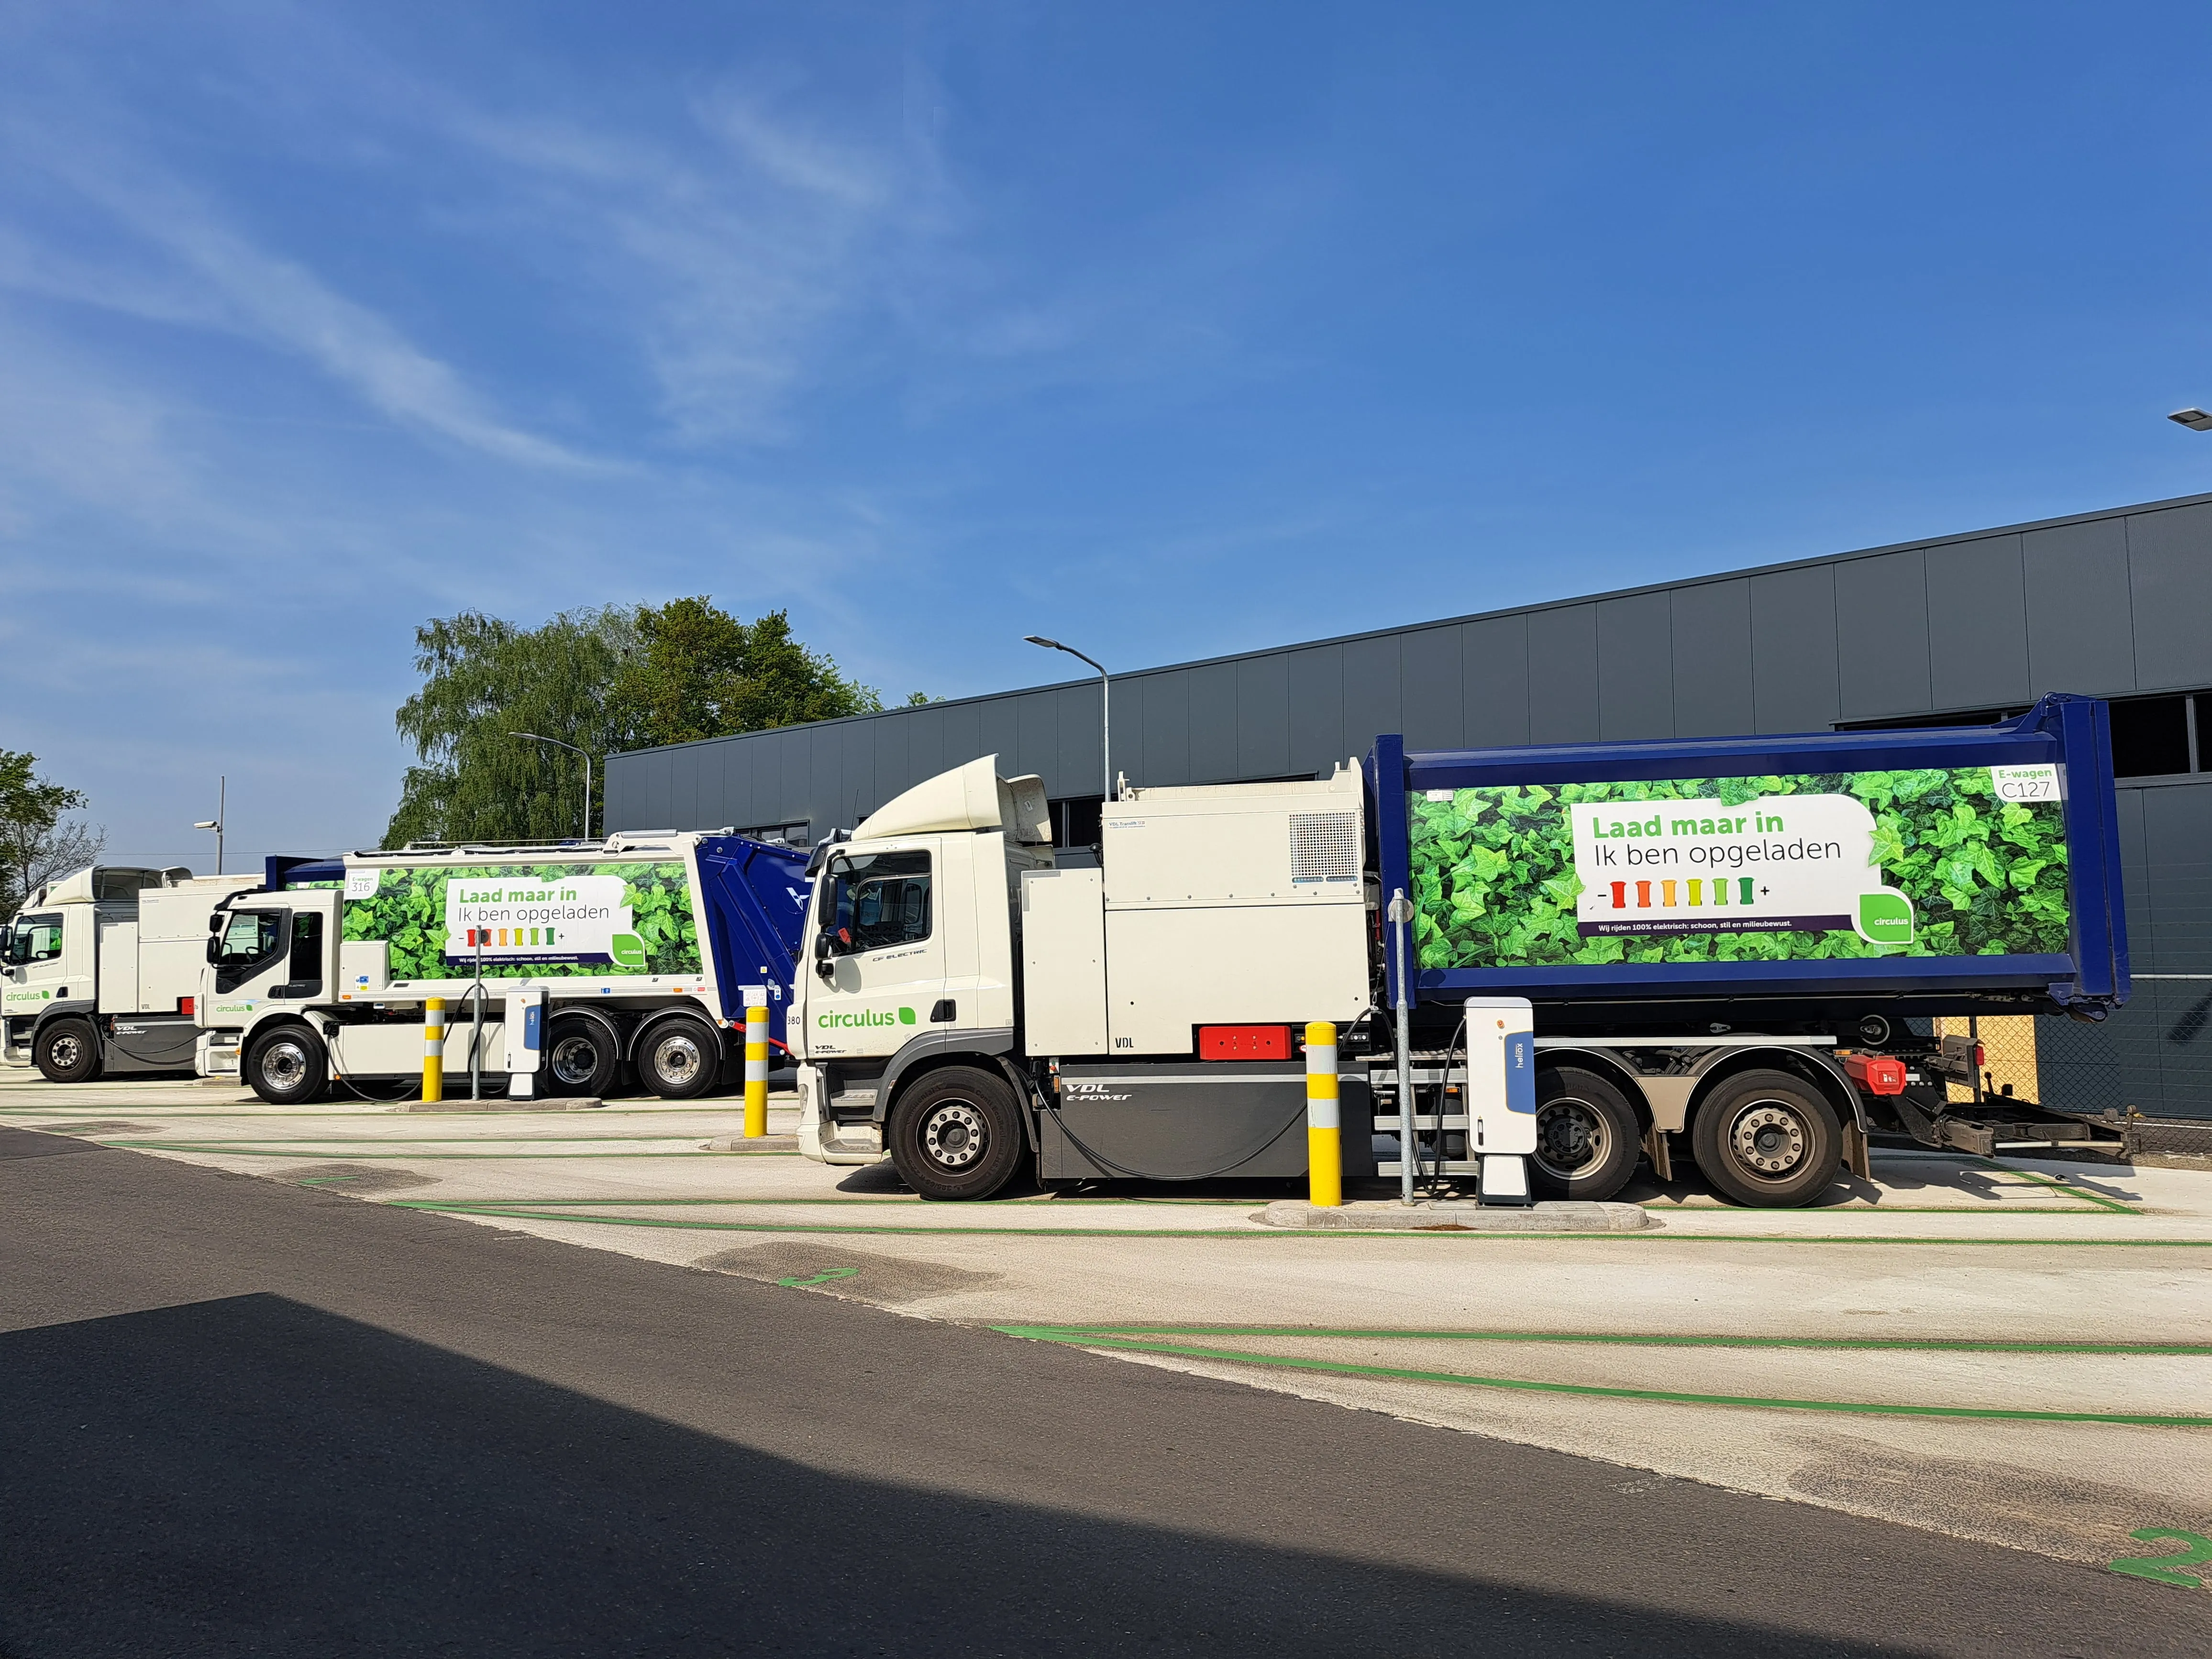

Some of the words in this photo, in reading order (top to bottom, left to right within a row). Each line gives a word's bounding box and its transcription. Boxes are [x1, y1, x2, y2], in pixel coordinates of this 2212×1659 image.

[1998, 770, 2052, 779] E-wagen
[2002, 781, 2050, 798] C127
[1593, 815, 1661, 838] Laad
[1671, 817, 1747, 836] maar
[1755, 811, 1783, 832] in
[1595, 844, 1617, 866] Ik
[1627, 844, 1679, 865] ben
[1689, 838, 1841, 868] opgeladen
[352, 882, 370, 892] 316
[459, 888, 503, 903] Laad
[508, 890, 555, 902] maar
[560, 886, 577, 901] in
[459, 907, 472, 922] Ik
[478, 907, 510, 921] ben
[517, 905, 609, 924] opgeladen
[1874, 917, 1909, 925] circulus
[1611, 924, 1631, 932] rijden
[886, 949, 928, 960] ELECTRIC
[6, 991, 40, 1001] circulus
[216, 1004, 245, 1012] circulus
[787, 1016, 800, 1025] 380
[818, 1008, 895, 1028] circulus
[1115, 1037, 1134, 1048] VDL
[1515, 1043, 1524, 1068] heliox
[1066, 1084, 1110, 1093] VDL
[2108, 1527, 2212, 1589] 2
